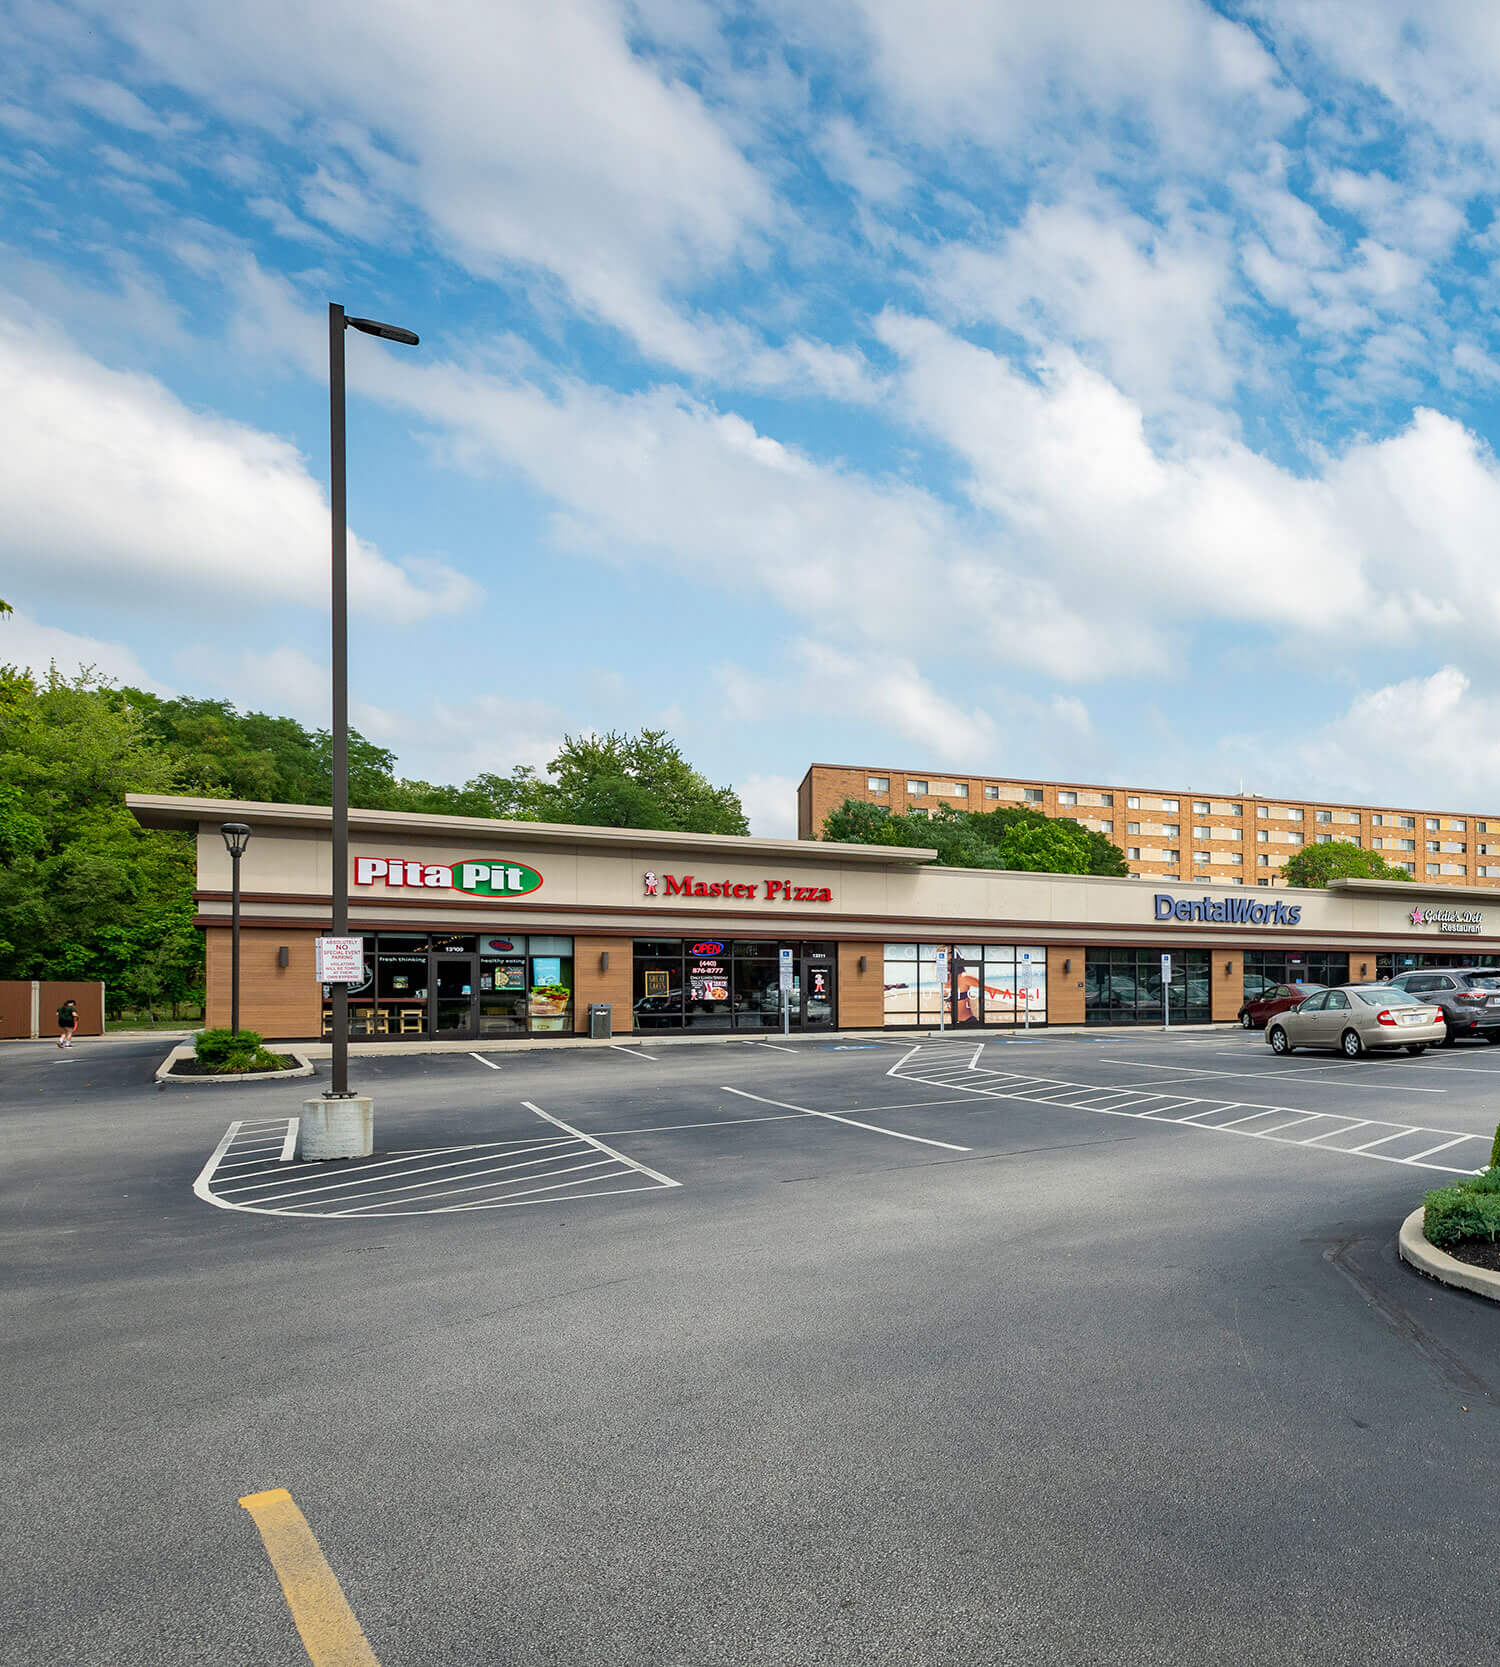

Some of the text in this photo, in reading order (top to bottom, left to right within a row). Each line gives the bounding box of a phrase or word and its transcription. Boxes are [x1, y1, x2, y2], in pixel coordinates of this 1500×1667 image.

[354, 857, 524, 890] Pita Pit
[664, 874, 832, 901] Master Pizza
[1154, 894, 1302, 925] DentalWorks
[1441, 922, 1483, 933] Restaurant
[692, 943, 721, 954] OPEN
[398, 956, 427, 964] thinking
